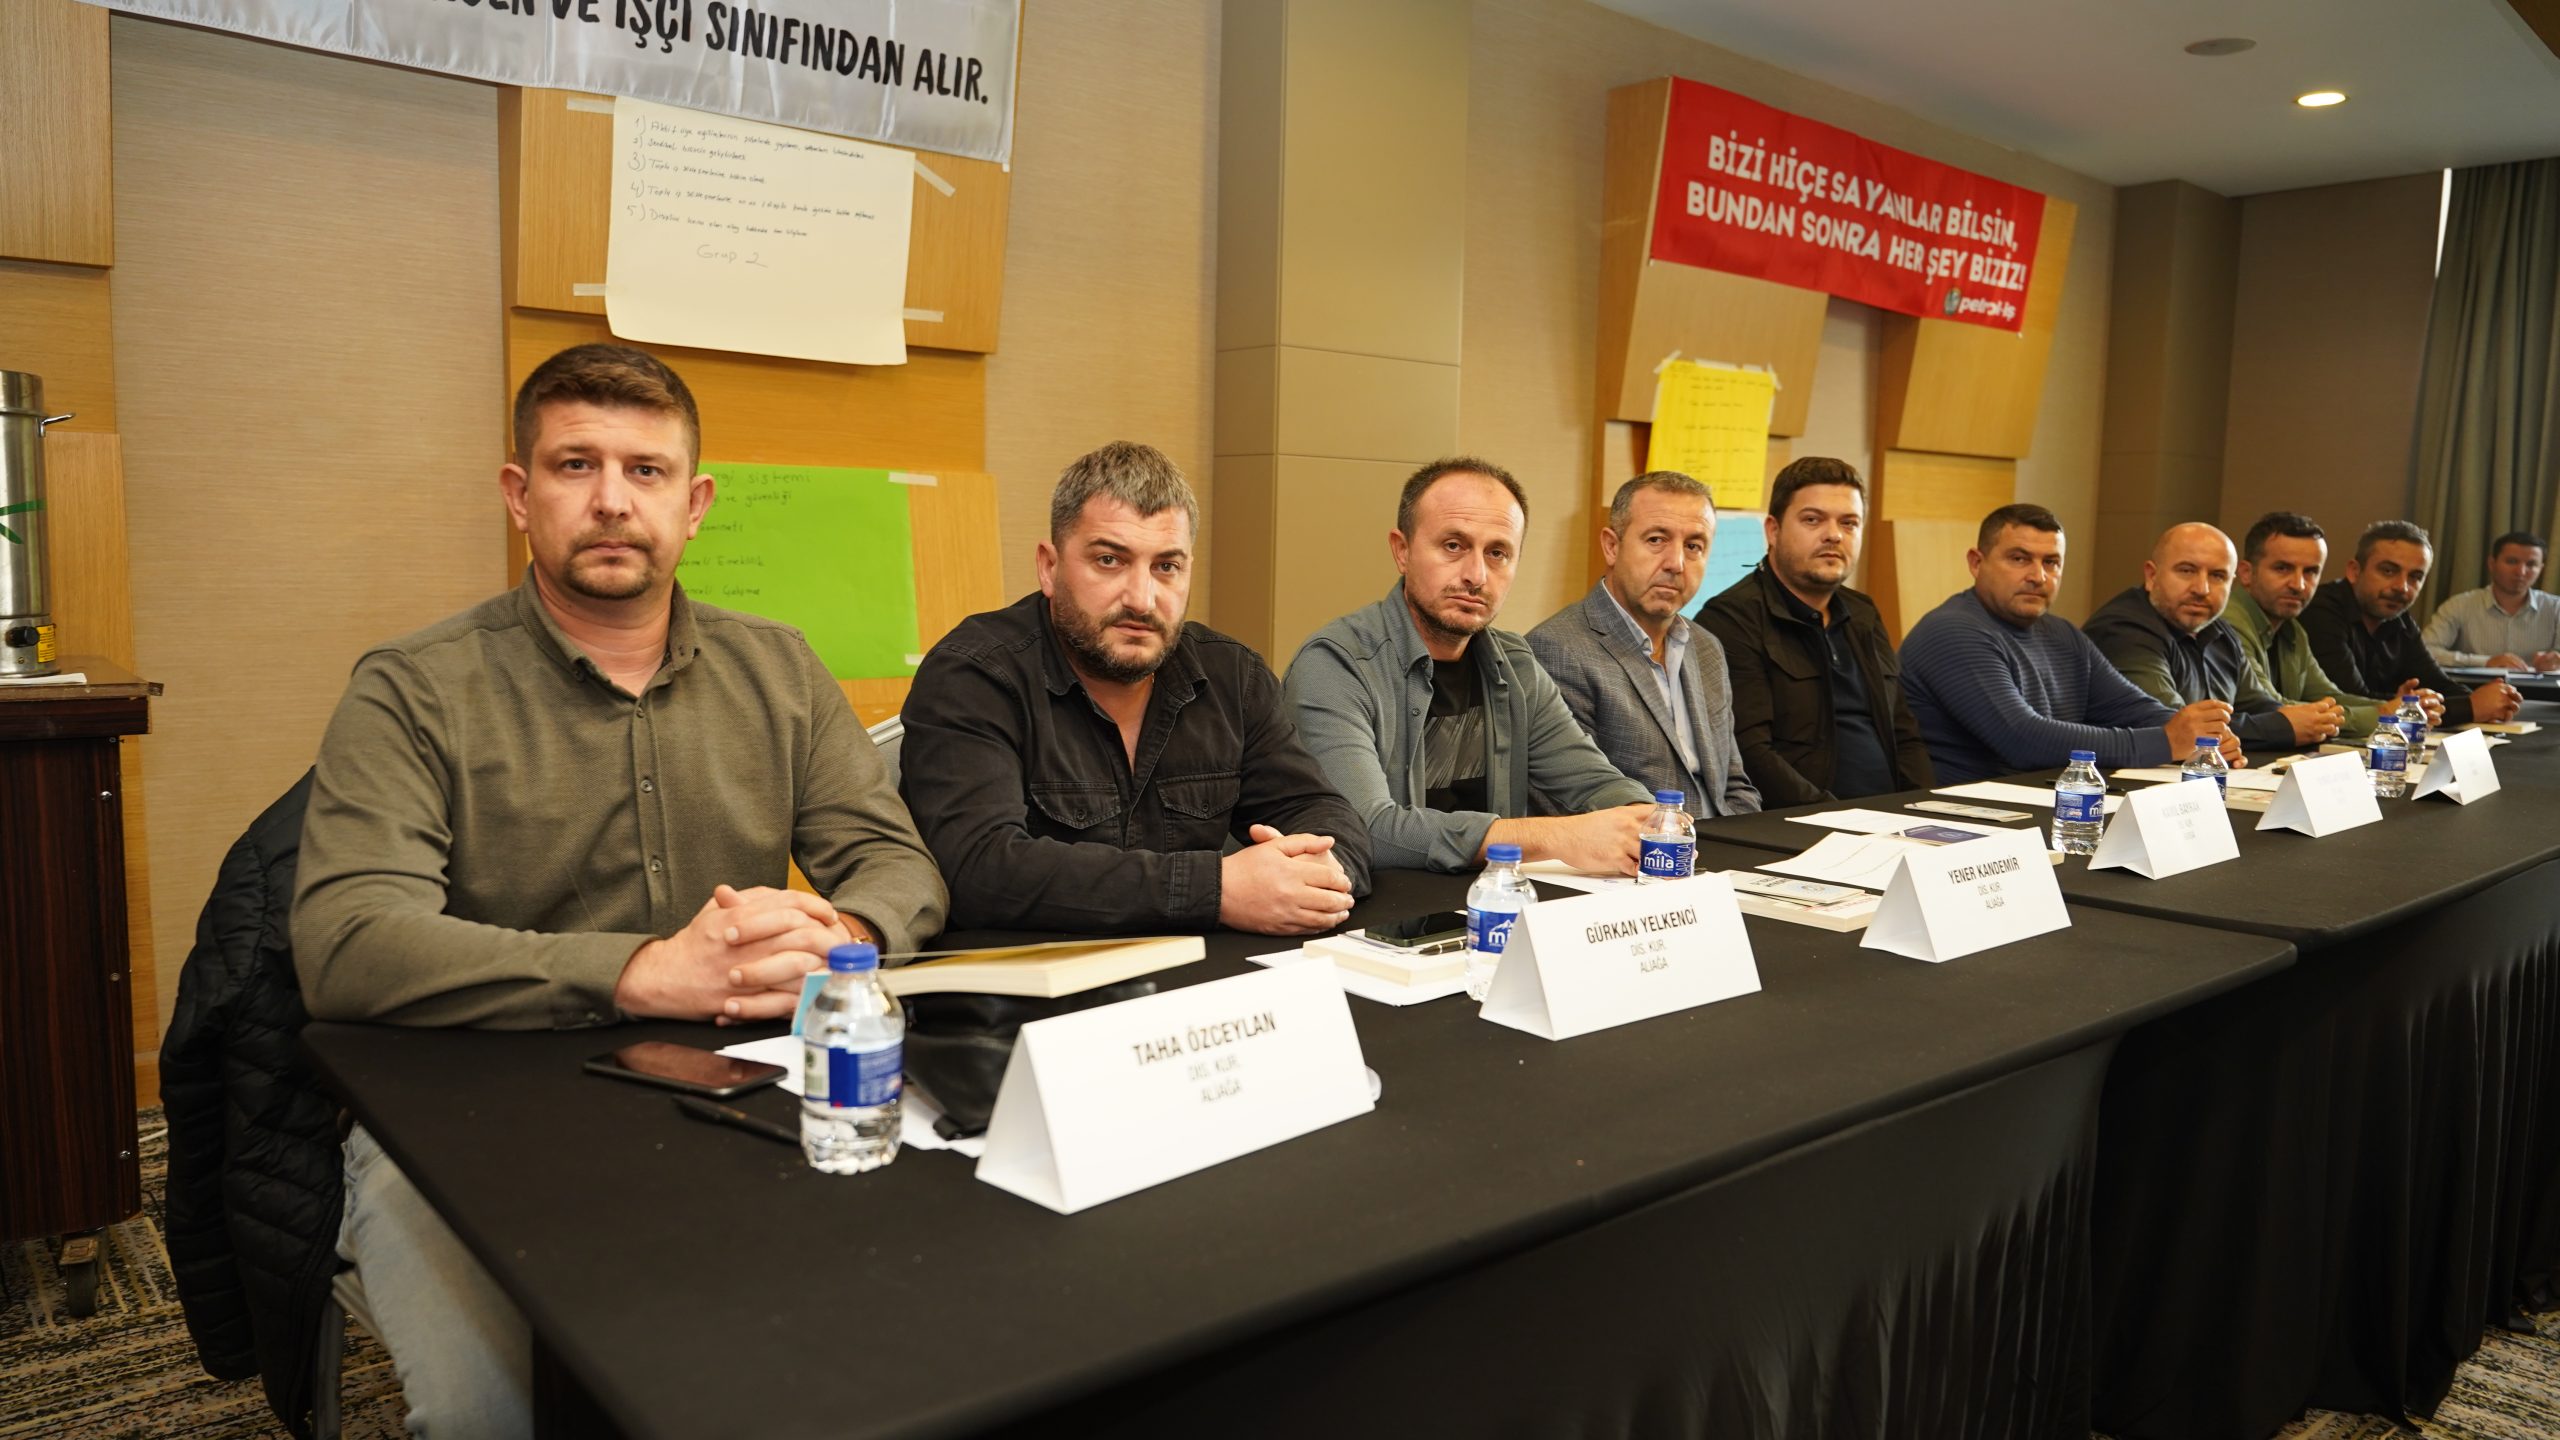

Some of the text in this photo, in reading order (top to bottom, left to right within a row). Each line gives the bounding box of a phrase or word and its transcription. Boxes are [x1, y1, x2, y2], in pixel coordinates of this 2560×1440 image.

[706, 2, 904, 86] SINIFINDAN
[913, 49, 988, 104] ALIR.
[1708, 130, 2018, 252] BİZİ HİÇE SAYANLAR BİLSİN,
[697, 244, 737, 263] Grup
[1687, 181, 2026, 292] BUNDAN SONRA HER ŞEY BİZİZ!
[1644, 856, 1675, 869] mila
[1675, 844, 1692, 876] SAPANCA
[1947, 855, 2020, 885] YENER KANDEMİR
[1586, 904, 1698, 945] GÜRKAN YELKENCİ
[1132, 1011, 1277, 1066] TAHA ÖZCEYLAN
